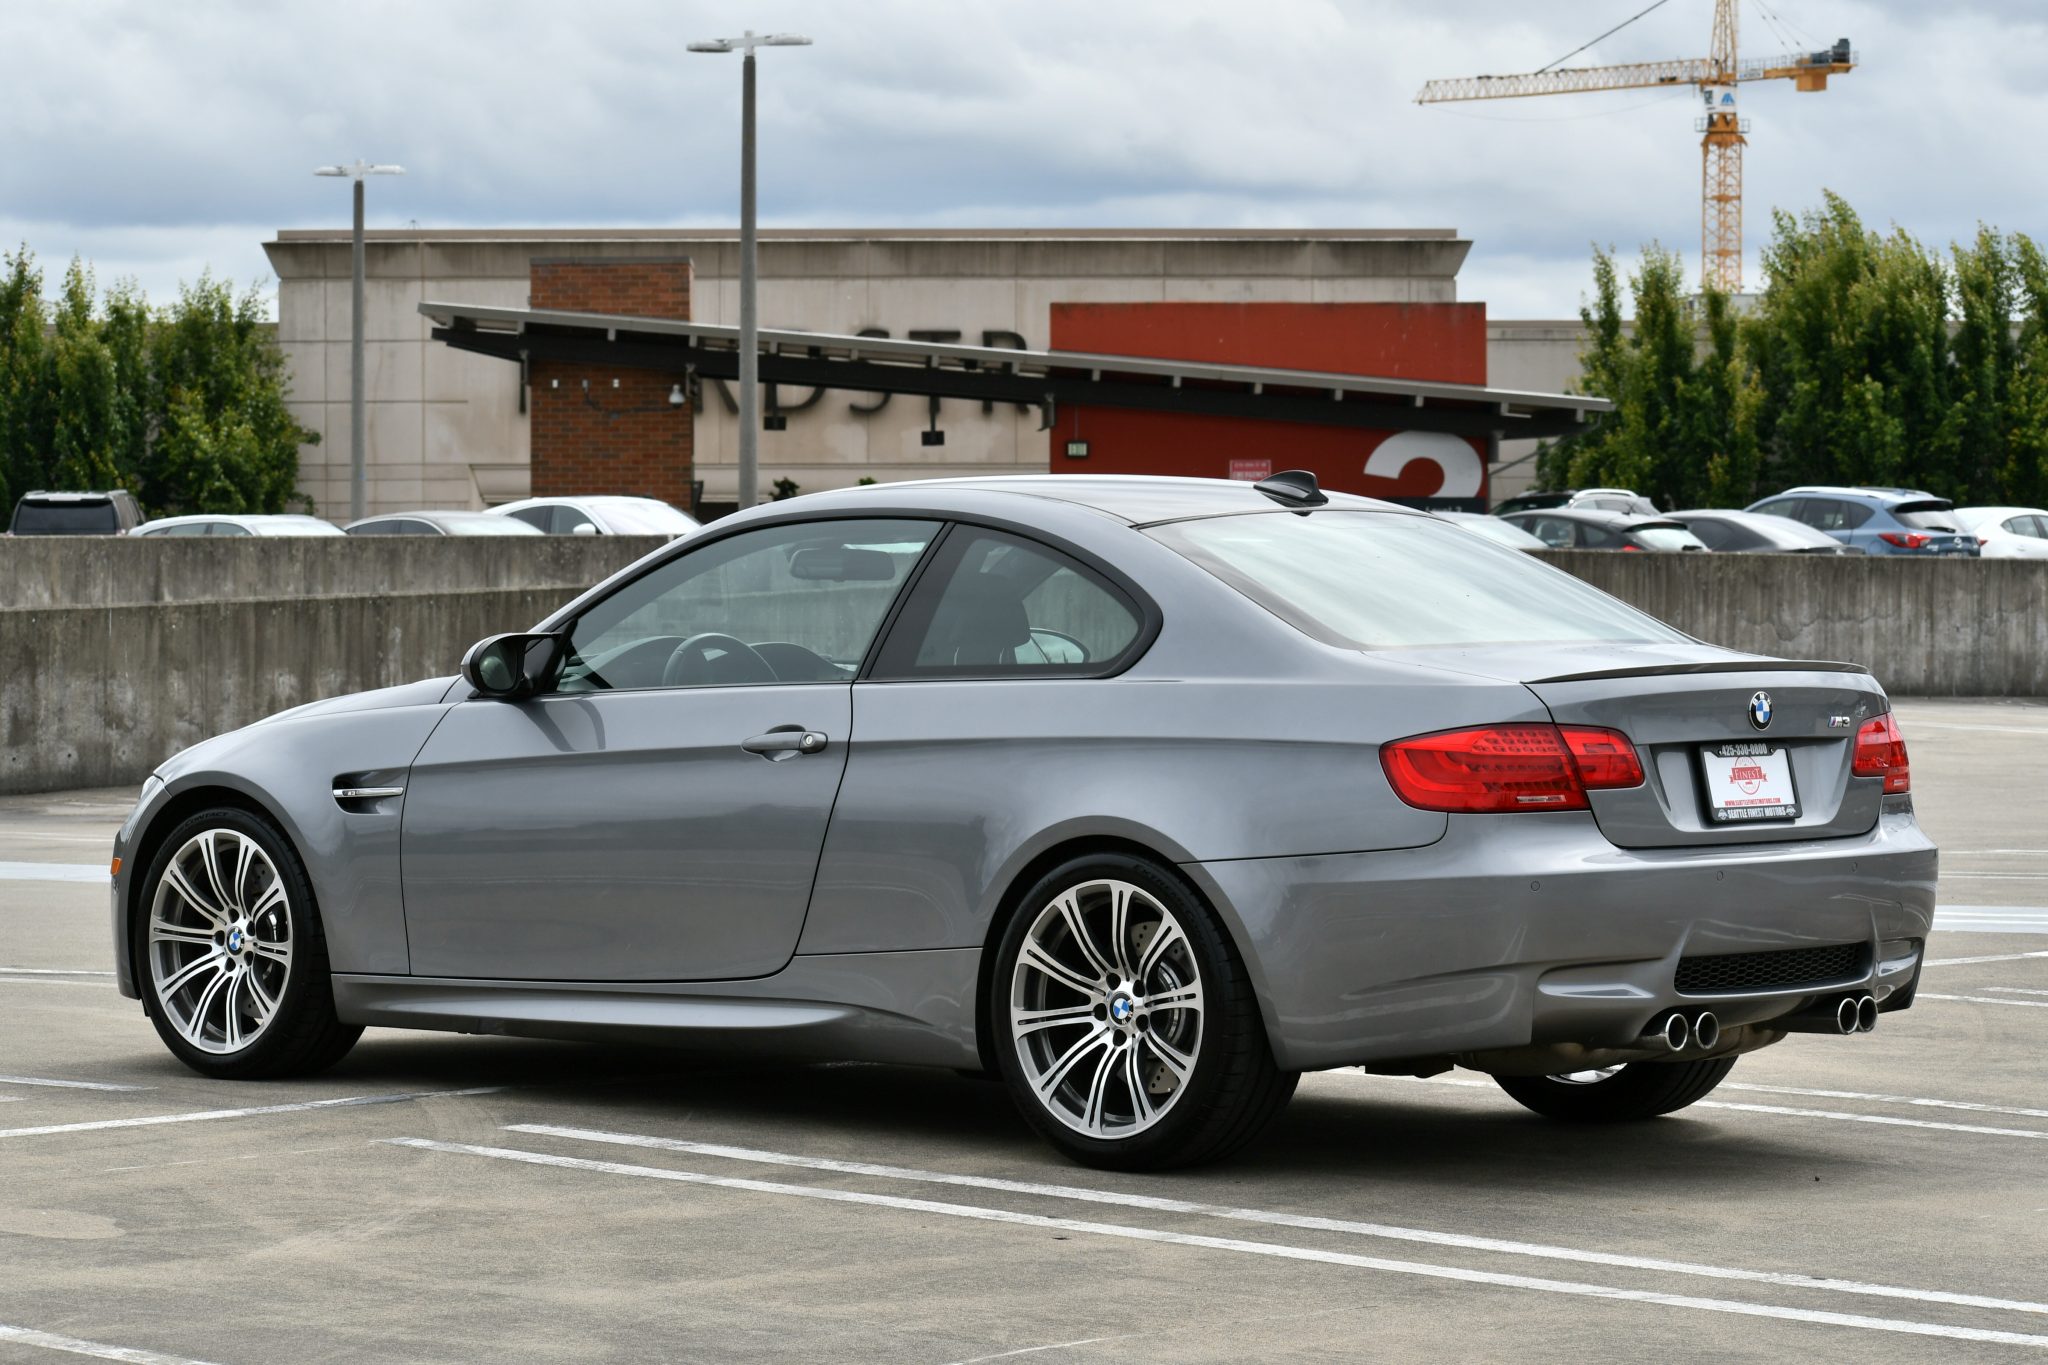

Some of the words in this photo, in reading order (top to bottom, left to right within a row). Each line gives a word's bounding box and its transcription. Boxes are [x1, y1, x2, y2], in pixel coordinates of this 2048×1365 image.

[1828, 716, 1850, 728] M3
[1734, 768, 1761, 780] FINEST
[1727, 808, 1748, 819] SEATTLE
[1748, 807, 1764, 818] FINEST
[1764, 806, 1787, 817] MOTORS
